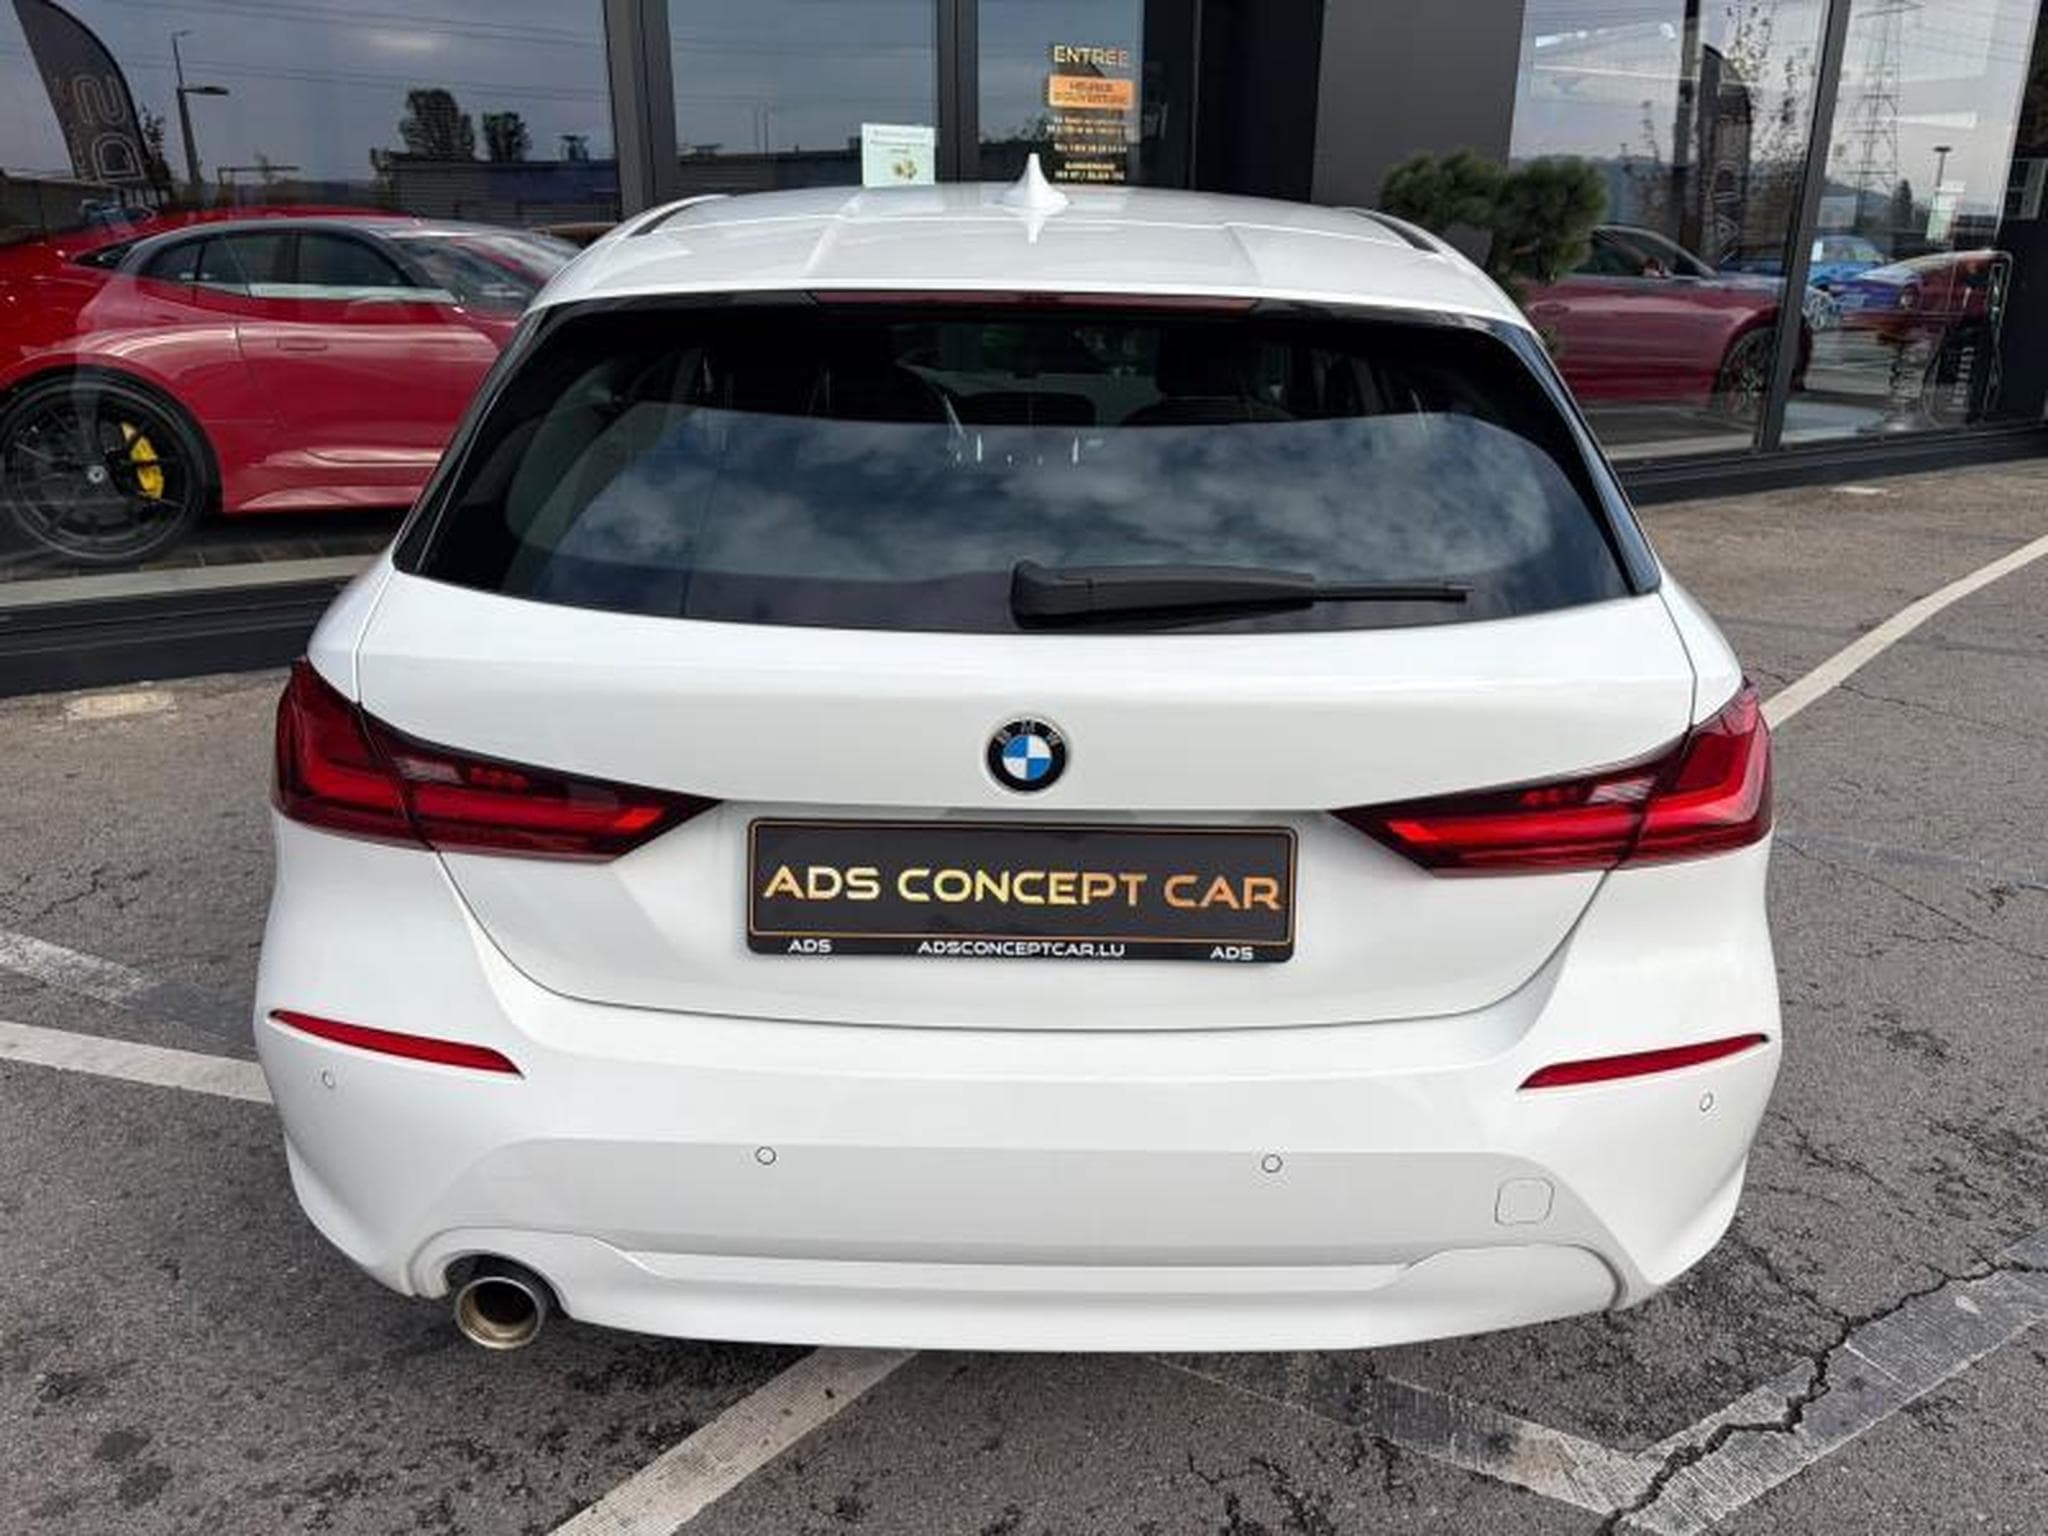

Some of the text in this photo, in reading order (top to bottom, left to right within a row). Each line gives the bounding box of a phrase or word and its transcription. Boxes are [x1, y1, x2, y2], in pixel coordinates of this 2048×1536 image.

[763, 865, 1282, 910] ADS CONCEPT CAR
[787, 938, 832, 954] ADS
[917, 940, 1126, 958] ADSCONCEPTCAR.LU
[1209, 945, 1254, 961] ADS
